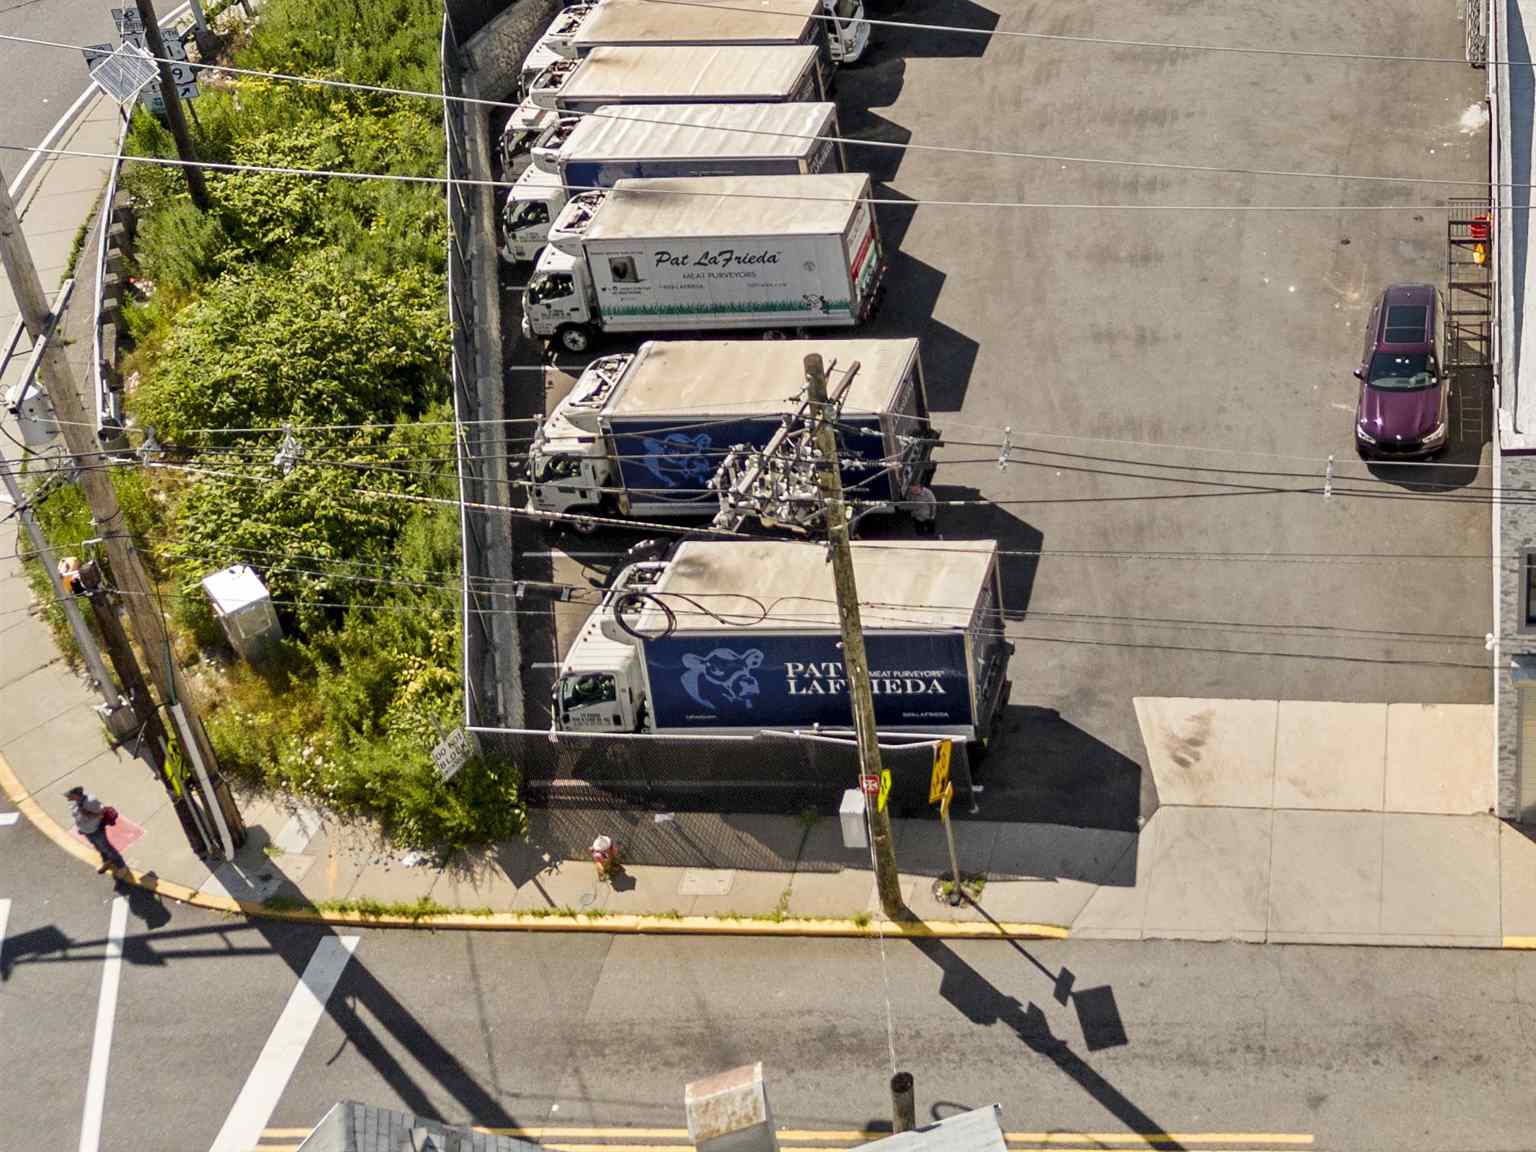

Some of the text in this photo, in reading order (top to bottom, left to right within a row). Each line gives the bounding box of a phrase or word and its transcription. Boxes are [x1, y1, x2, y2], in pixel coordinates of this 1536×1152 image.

[172, 67, 183, 80] 9
[655, 249, 780, 269] Pat LaFrieda
[784, 662, 843, 678] PAT
[787, 678, 947, 695] LAFIEDA
[435, 747, 447, 761] DO
